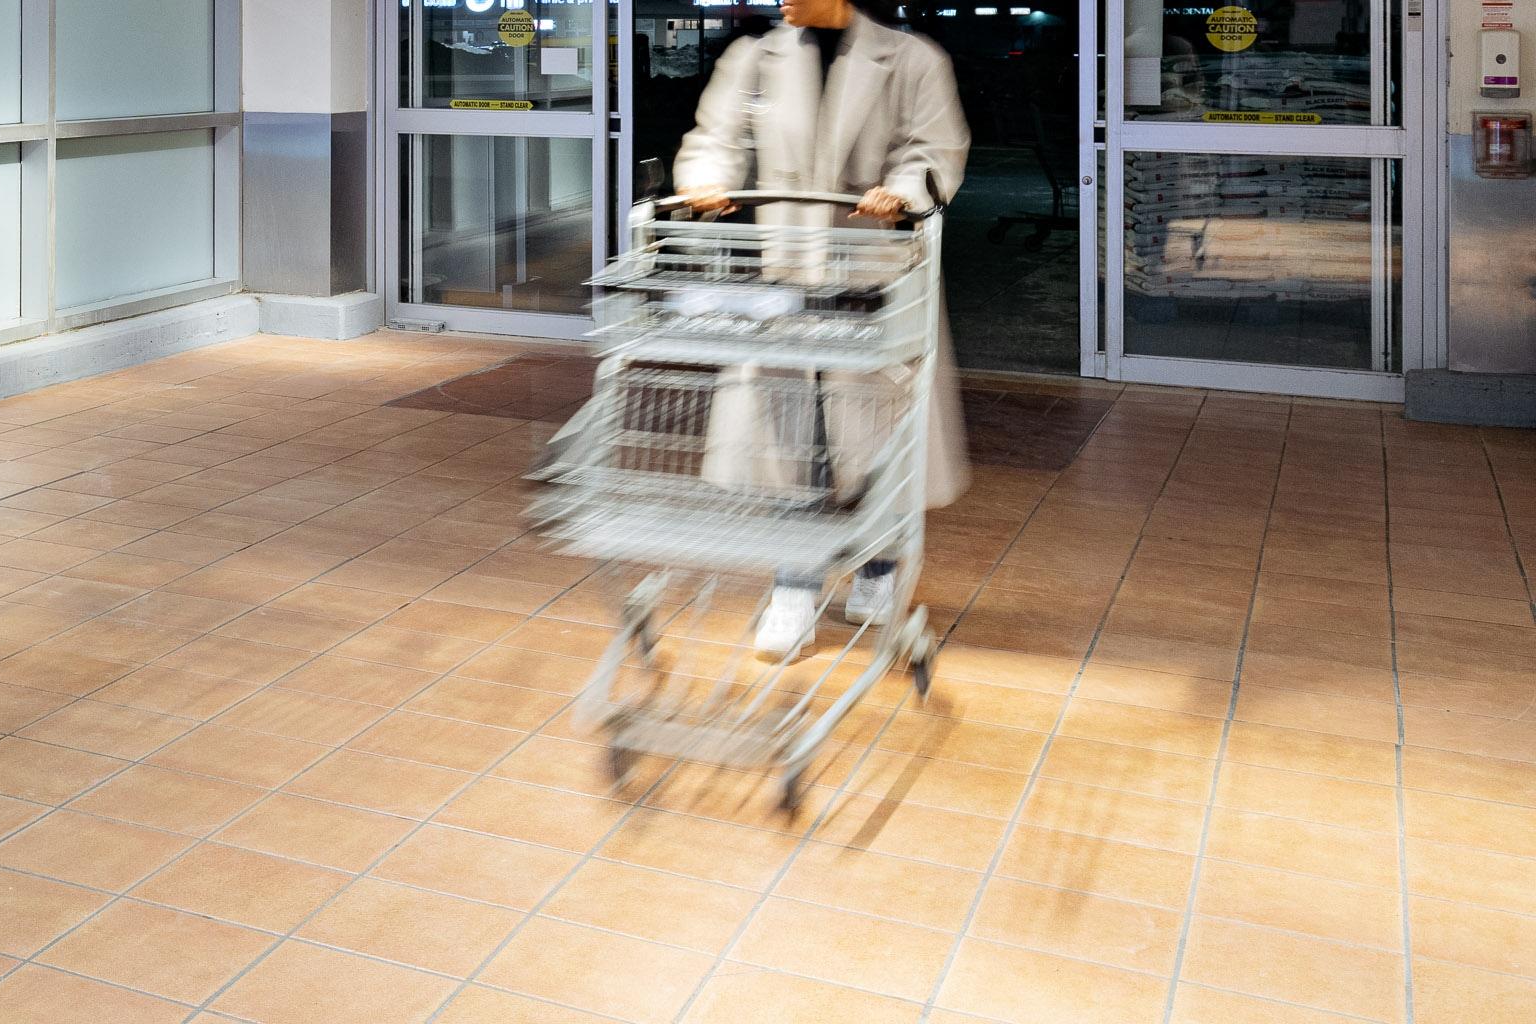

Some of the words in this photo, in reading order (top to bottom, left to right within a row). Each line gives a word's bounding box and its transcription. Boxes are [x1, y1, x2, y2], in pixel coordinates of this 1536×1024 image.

[1208, 24, 1255, 33] CAUTION
[1208, 113, 1242, 121] AUTOMATIC
[1243, 113, 1260, 121] DOOR
[1274, 114, 1294, 122] STAND
[1295, 114, 1315, 122] CLEAR
